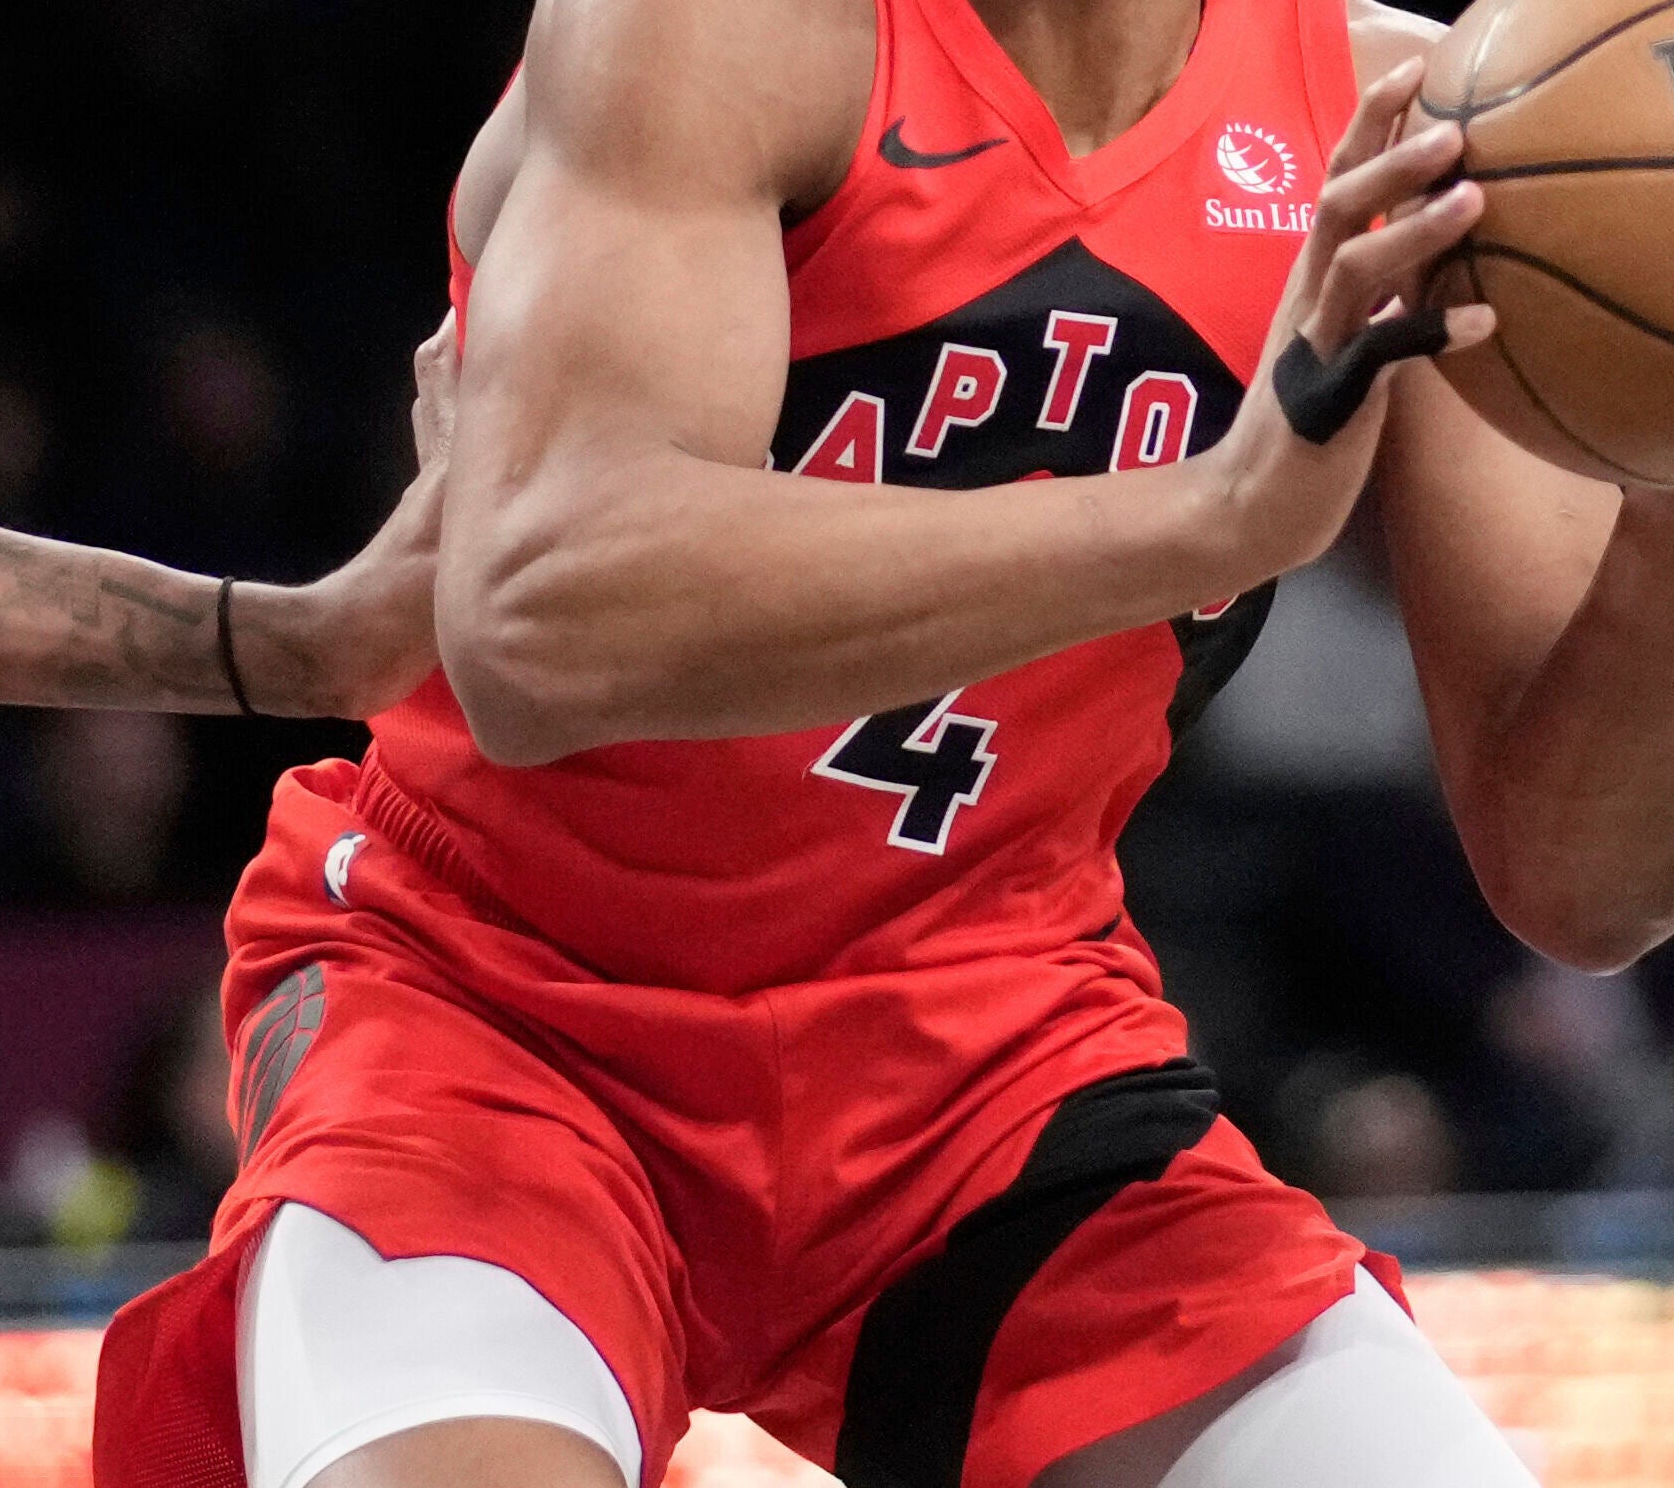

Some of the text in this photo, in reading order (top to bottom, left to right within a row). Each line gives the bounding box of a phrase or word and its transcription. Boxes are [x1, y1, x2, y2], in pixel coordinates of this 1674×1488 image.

[1205, 198, 1316, 233] Sun Lif
[811, 687, 998, 855] 4
